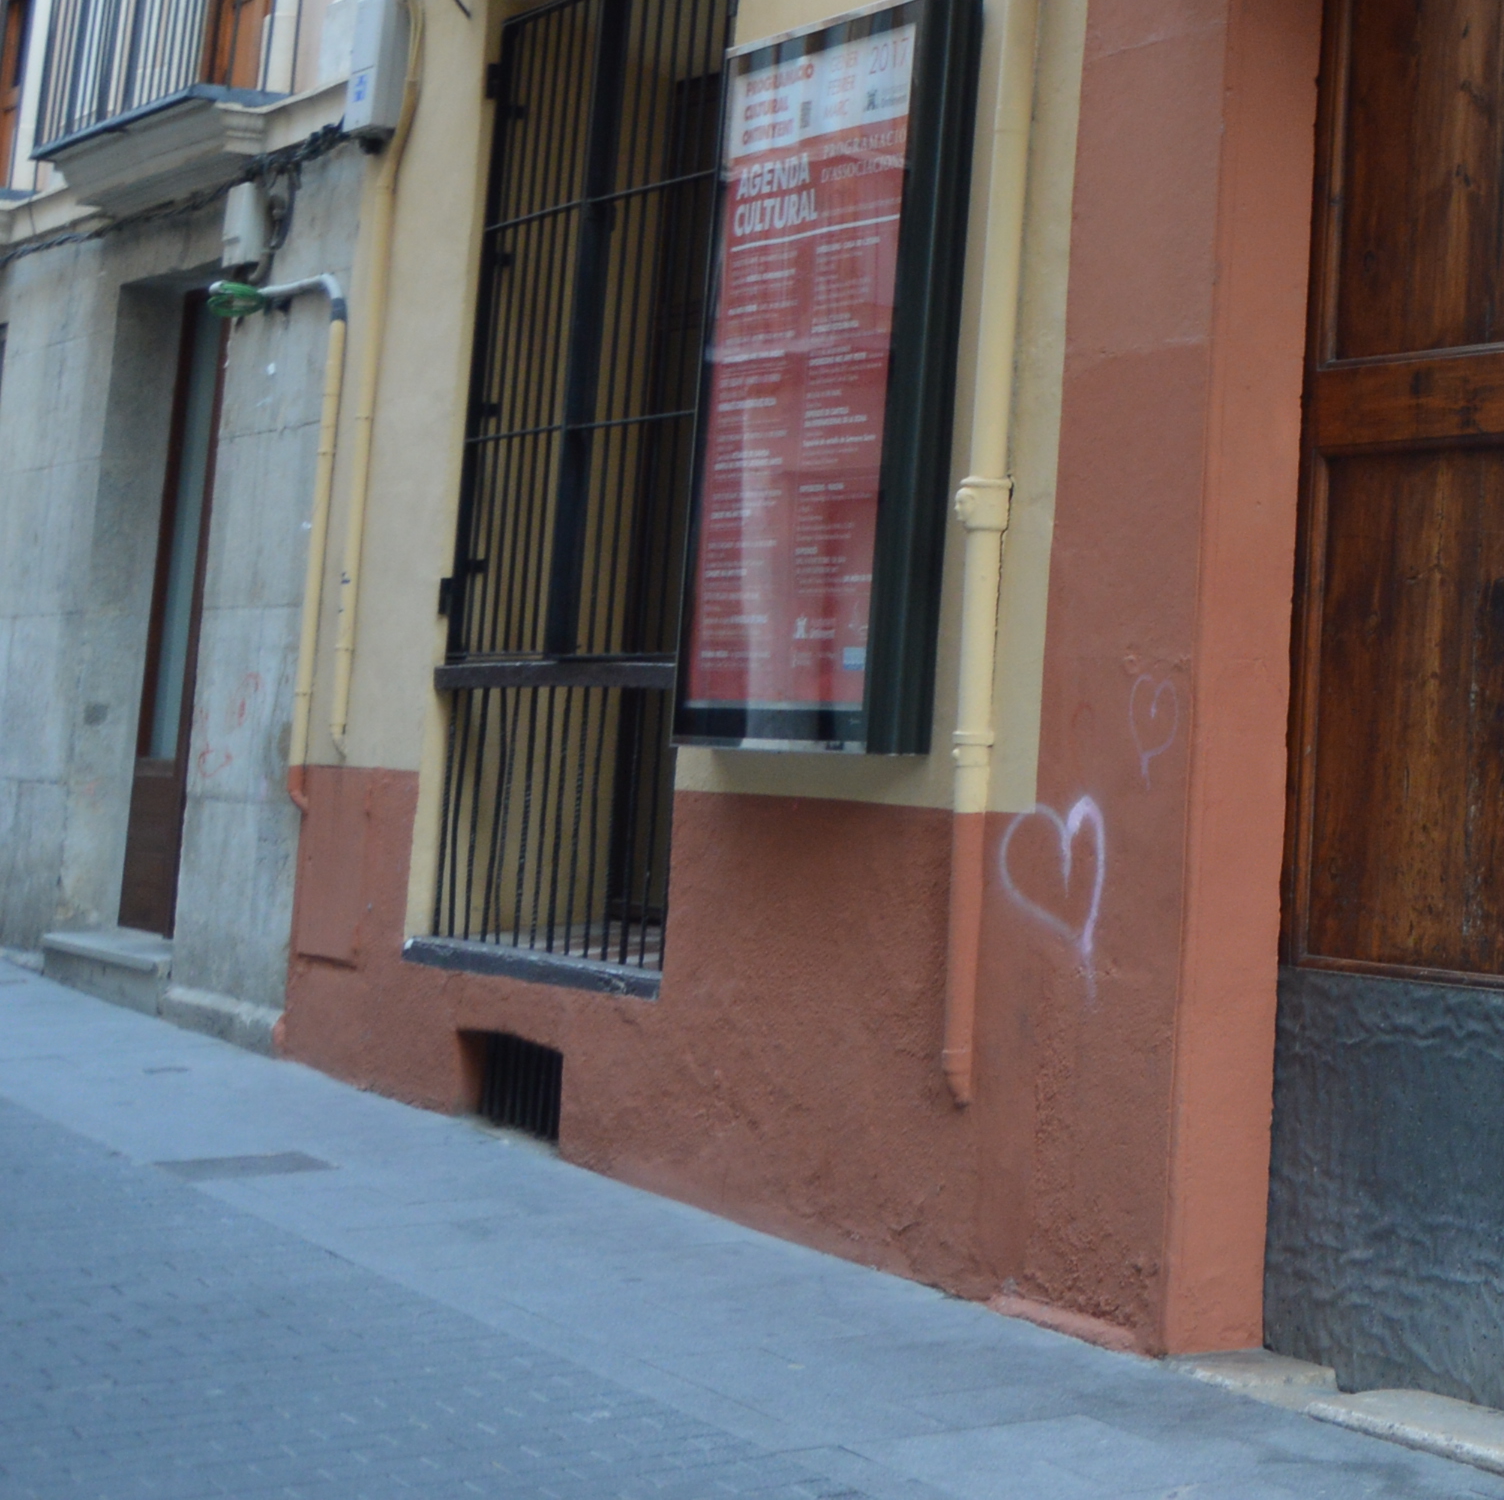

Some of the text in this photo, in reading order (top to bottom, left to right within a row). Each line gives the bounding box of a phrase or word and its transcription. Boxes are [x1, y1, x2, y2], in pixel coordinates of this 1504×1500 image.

[869, 37, 910, 75] 2017
[735, 153, 811, 200] AGENDA
[734, 188, 818, 237] CULTURAL
